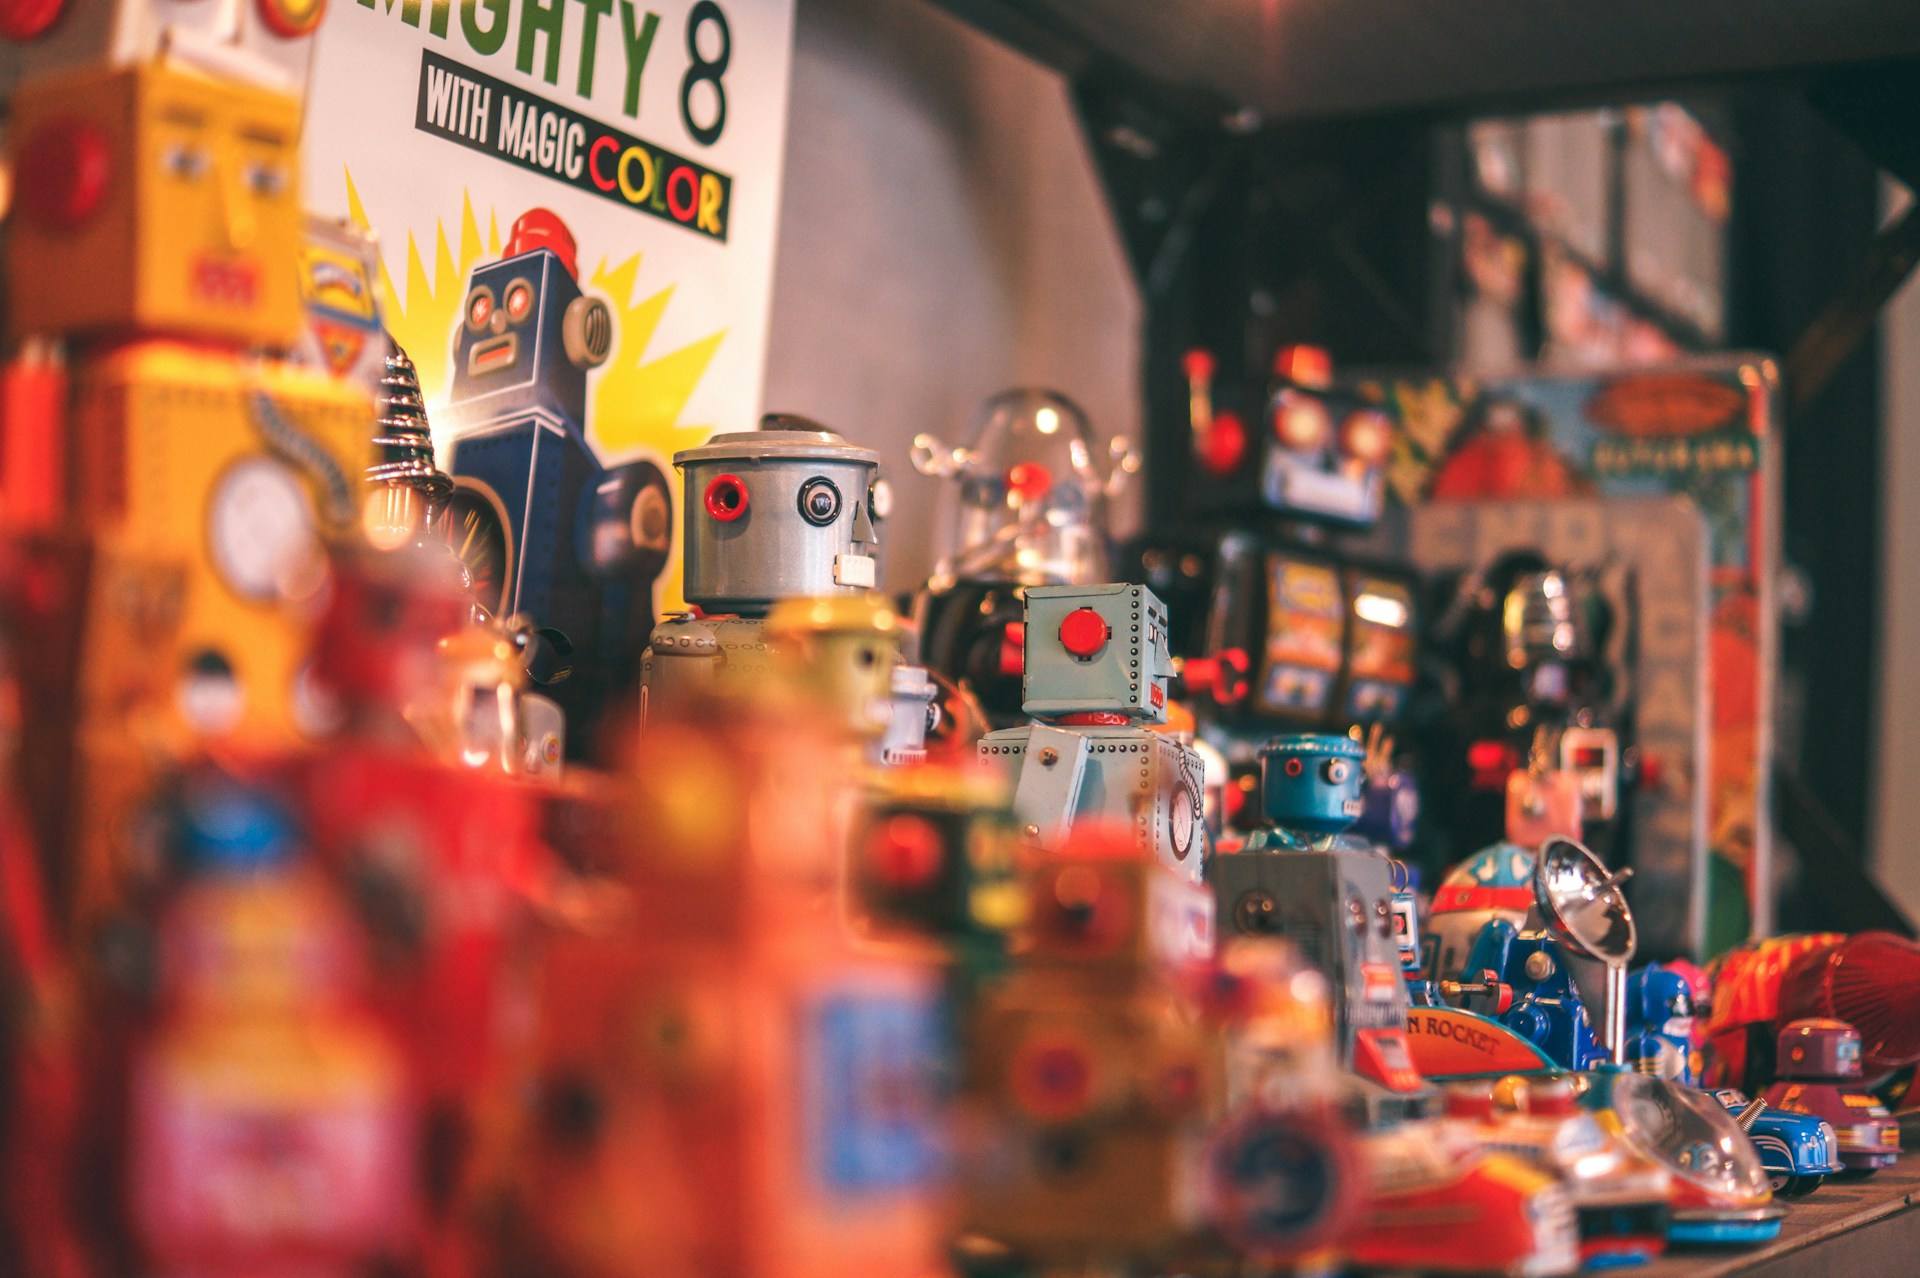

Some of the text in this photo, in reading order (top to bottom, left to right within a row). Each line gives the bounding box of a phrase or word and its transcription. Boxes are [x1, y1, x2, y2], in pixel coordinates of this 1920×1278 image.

[357, 0, 731, 147] GHTY 8
[426, 64, 724, 234] WITH MAGIC COLOR
[1426, 1017, 1500, 1055] ROCKET
